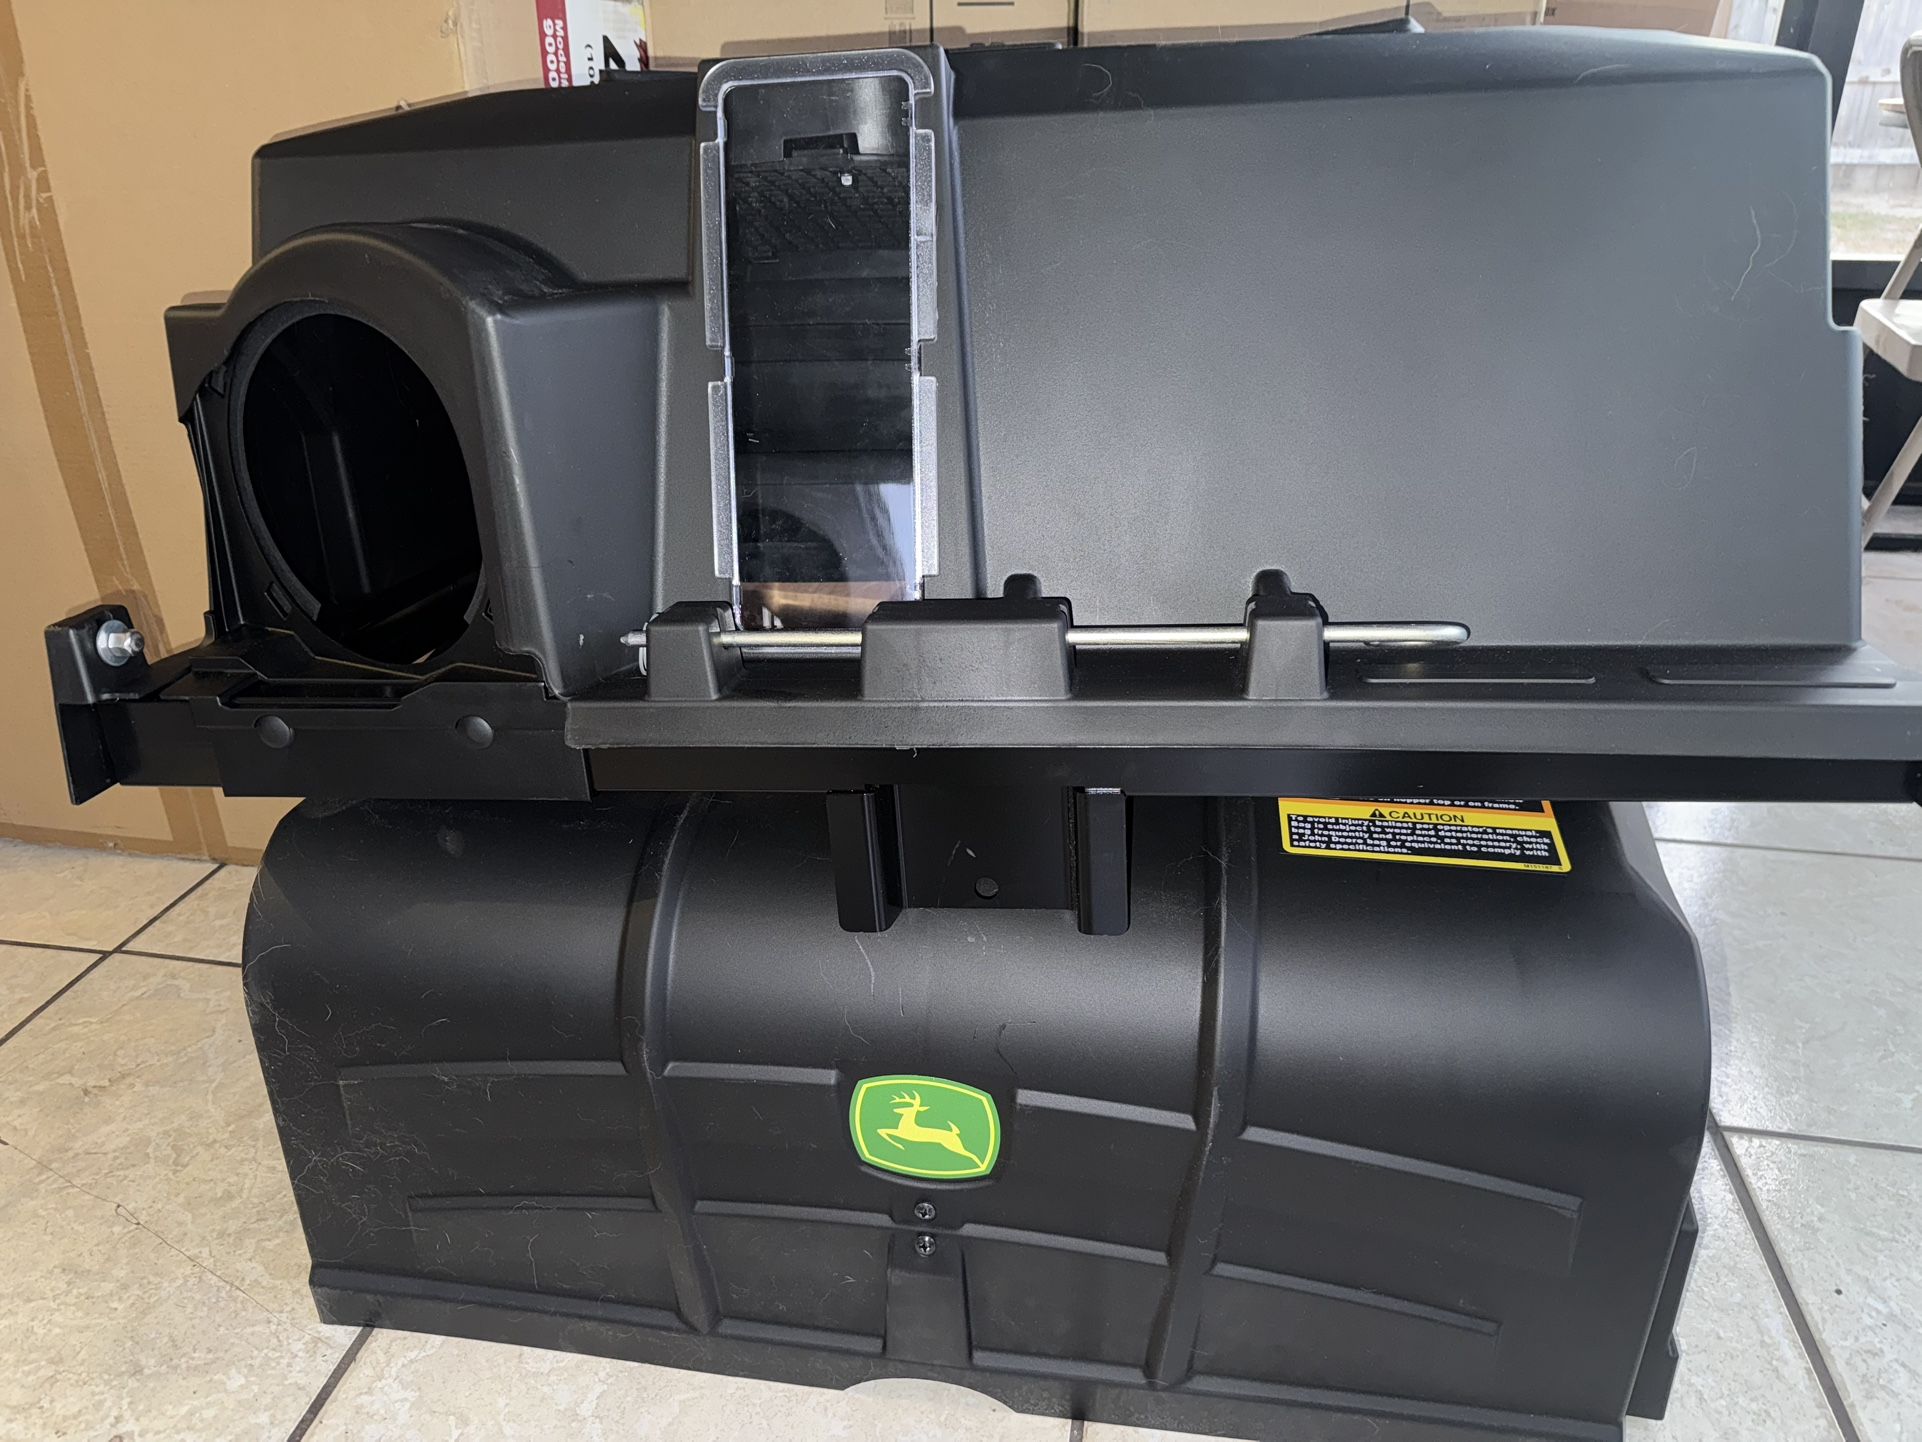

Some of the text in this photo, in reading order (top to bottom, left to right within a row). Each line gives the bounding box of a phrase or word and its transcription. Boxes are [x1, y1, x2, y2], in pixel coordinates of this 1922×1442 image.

[543, 18, 559, 88] 9000
[1484, 801, 1520, 810] frame.
[1388, 810, 1465, 823] CAUTION
[1291, 821, 1311, 829] Bag
[1439, 830, 1514, 842] deterioration,
[1516, 836, 1551, 844] check
[1339, 818, 1373, 826] injury,
[1376, 820, 1413, 828] ballast
[1437, 825, 1493, 833] operator's
[1496, 828, 1540, 836] manual.
[1314, 828, 1369, 838] frequently
[1396, 835, 1441, 843] replace,
[1460, 840, 1521, 848] necessary,
[1293, 841, 1412, 853] safety specifications.
[1404, 842, 1463, 851] equivalent
[1480, 847, 1521, 855] comply
[1524, 849, 1549, 857] with
